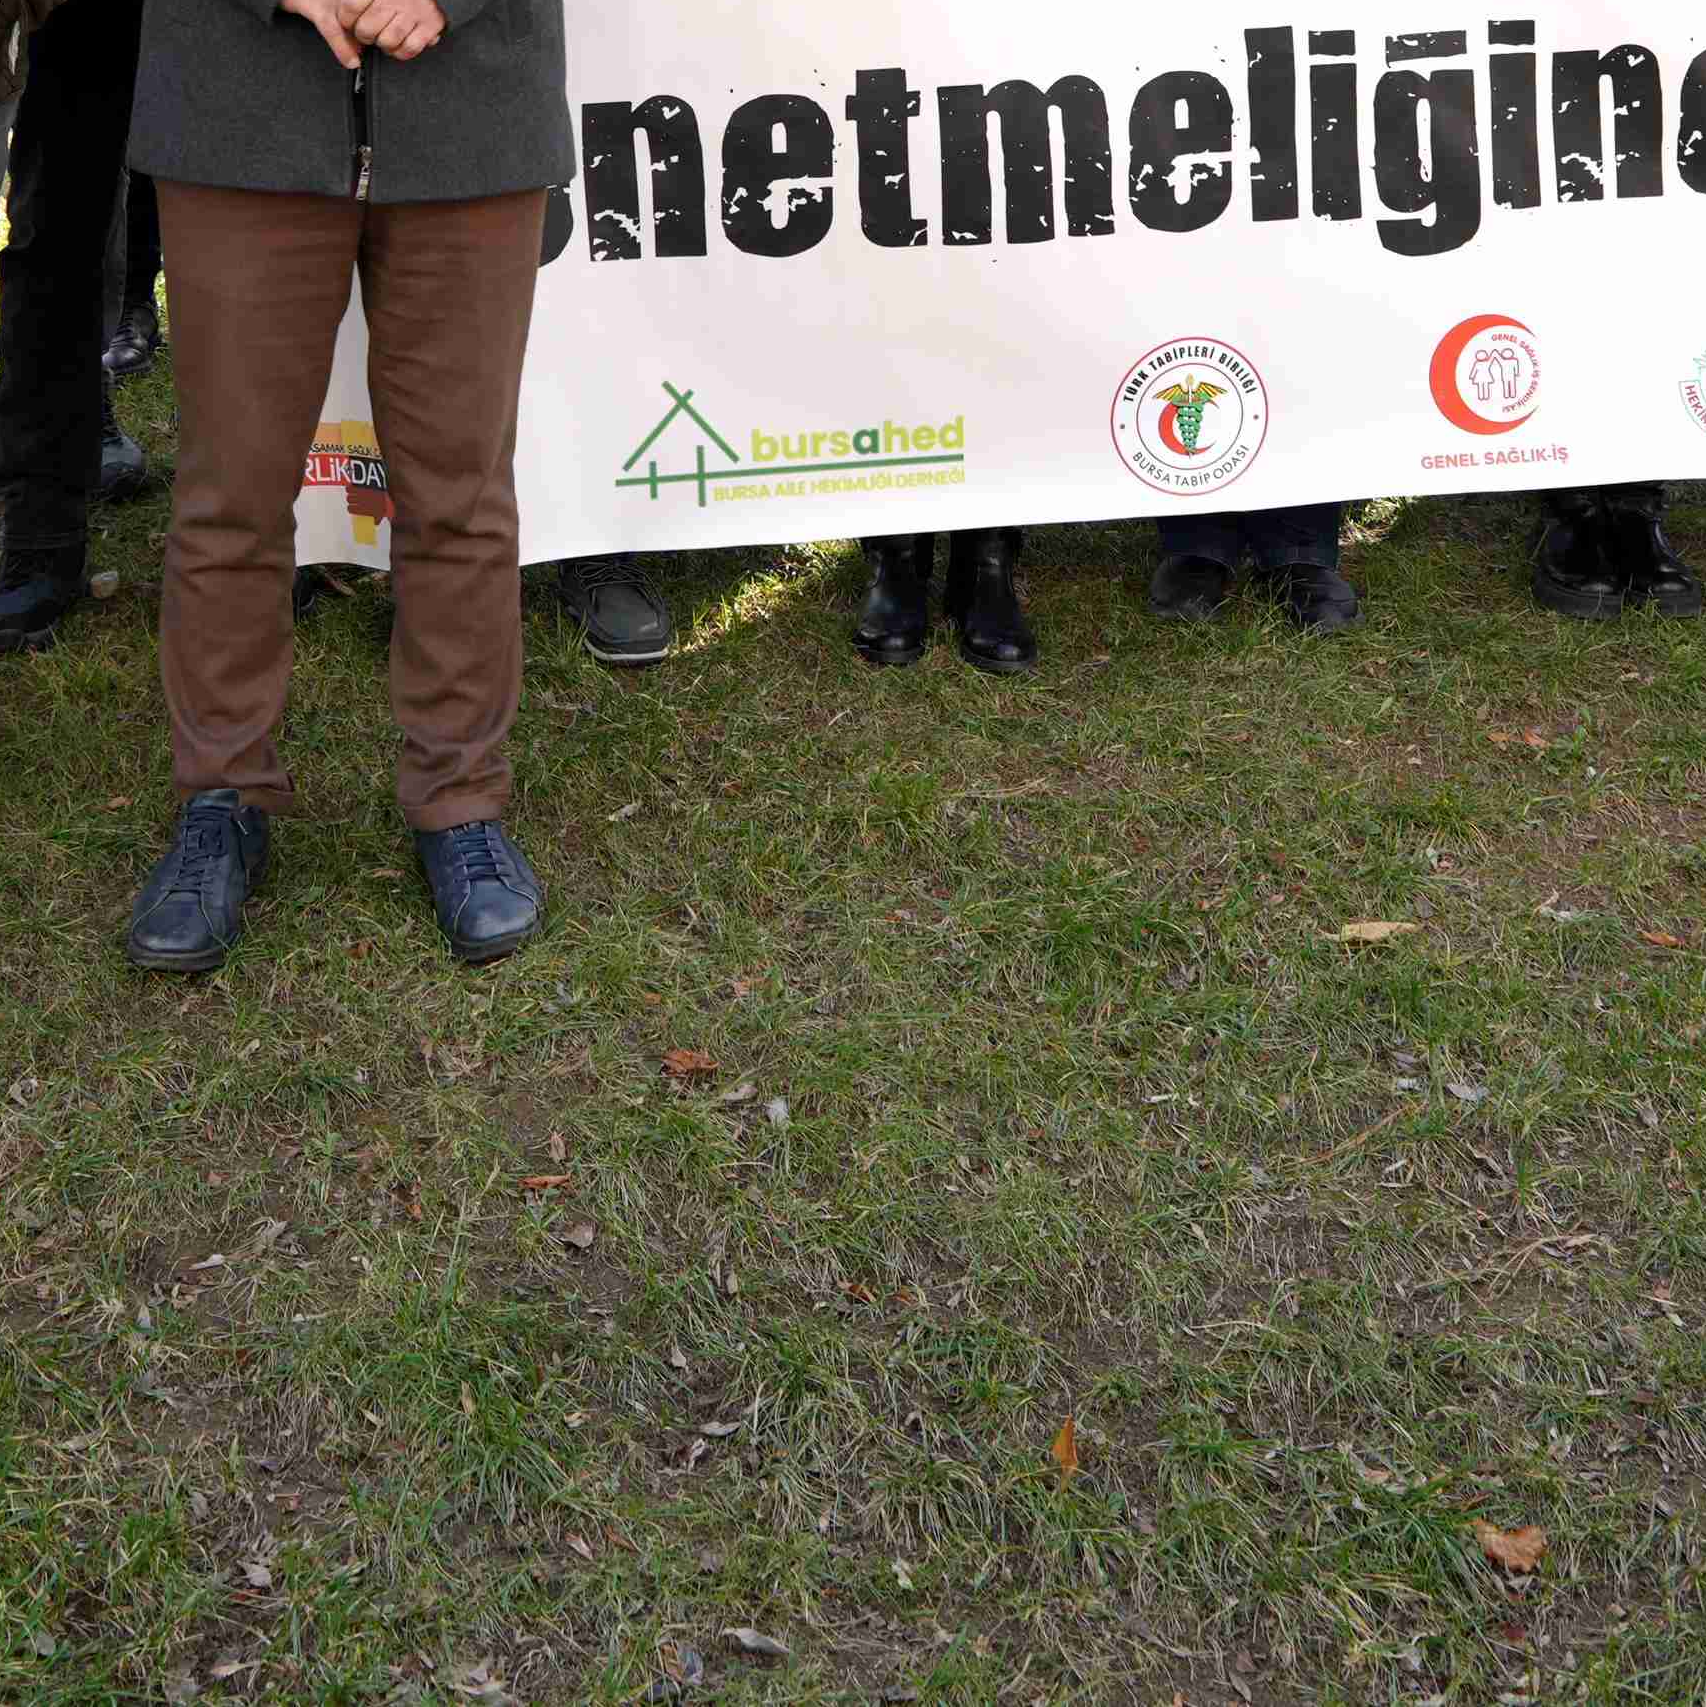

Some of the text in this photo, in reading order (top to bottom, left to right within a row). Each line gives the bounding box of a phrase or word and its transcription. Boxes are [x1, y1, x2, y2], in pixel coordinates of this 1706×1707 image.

[1123, 346, 1258, 403] TÜRK TABİPLERİ BİRLİĞİ
[752, 415, 965, 462] bursahed
[1420, 445, 1569, 470] GENEL SAĞLIK-İŞ
[1132, 444, 1250, 487] BURSA TABİP ODASI
[713, 484, 771, 501] BURSA
